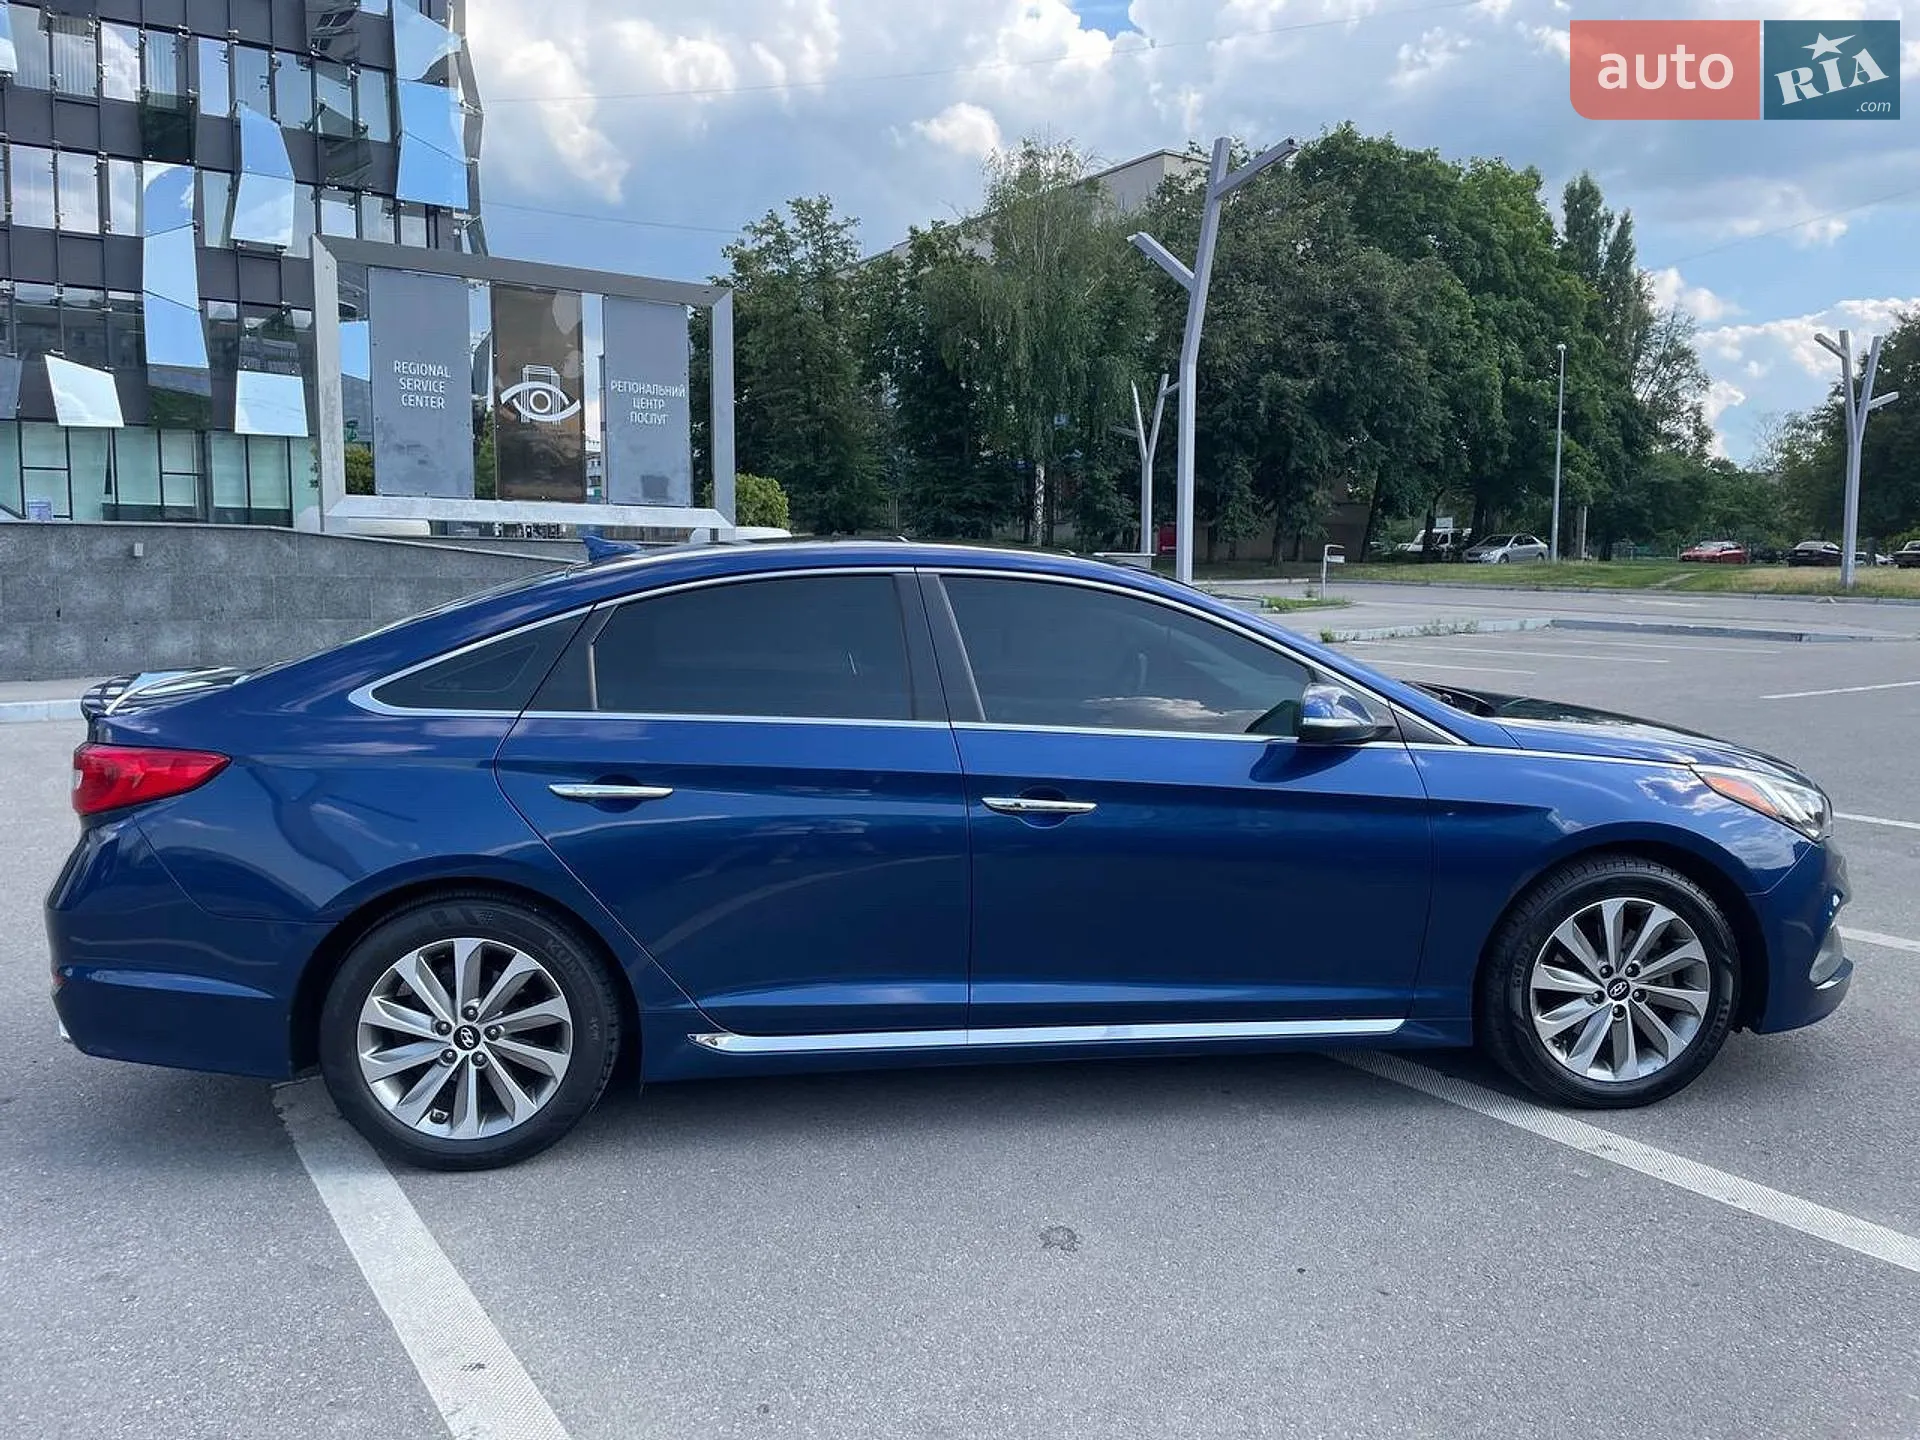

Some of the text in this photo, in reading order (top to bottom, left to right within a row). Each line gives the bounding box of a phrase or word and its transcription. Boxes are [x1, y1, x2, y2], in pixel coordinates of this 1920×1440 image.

[394, 360, 451, 378] REGIONAL
[399, 377, 445, 393] SERVICE
[610, 380, 686, 397] РЕГІОНАЛЬНИЙ
[401, 393, 445, 409] CENTER
[632, 397, 665, 410] ЦЕНТР
[629, 411, 669, 425] ПОСЛУГ
